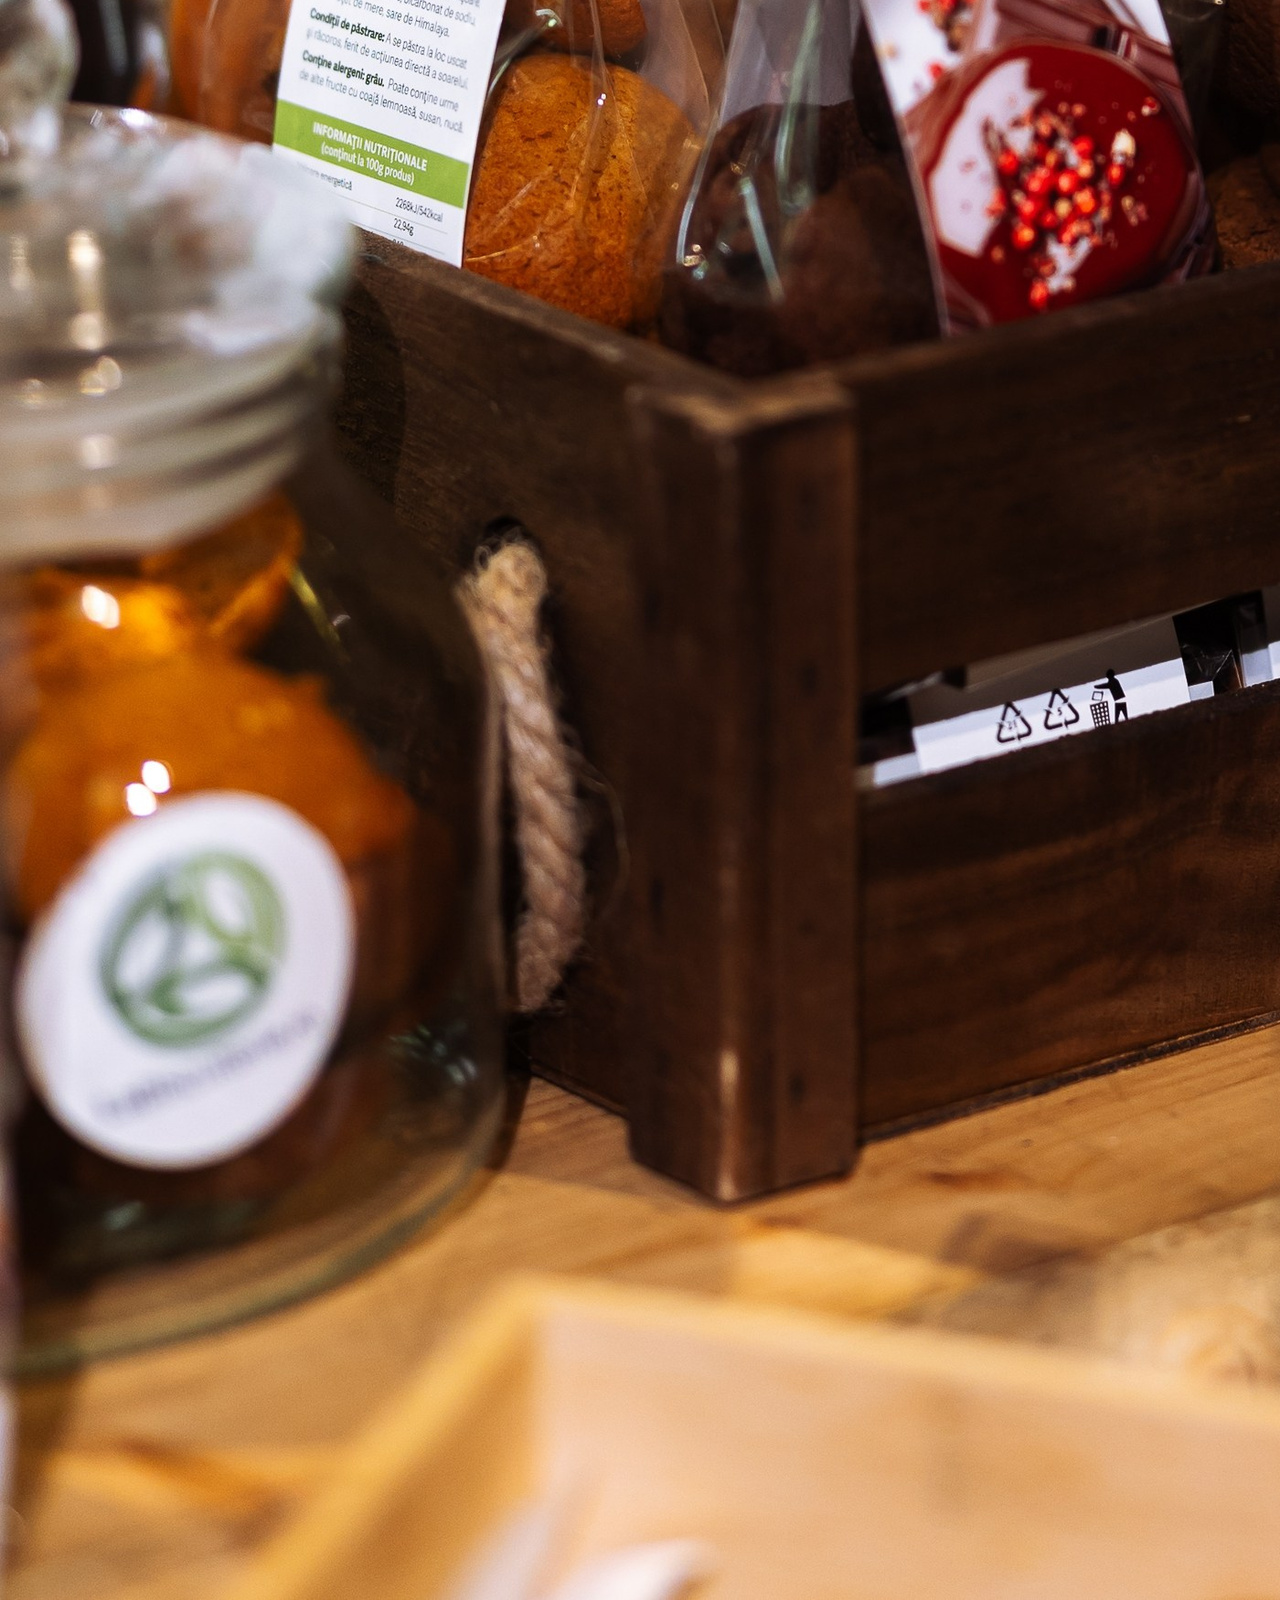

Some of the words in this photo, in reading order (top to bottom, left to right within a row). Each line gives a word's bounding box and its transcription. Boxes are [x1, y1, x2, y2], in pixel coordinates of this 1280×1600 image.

[385, 8, 403, 22] sare
[402, 12, 414, 26] de
[414, 15, 450, 37] Himalaya.
[443, 5, 455, 19] de
[340, 18, 351, 30] de
[350, 22, 386, 42] păstrare:
[385, 32, 392, 45] A
[392, 37, 402, 48] se
[402, 39, 426, 56] păstra
[426, 46, 434, 59] la
[434, 48, 446, 63] loc
[343, 37, 360, 54] ferit
[359, 43, 371, 57] de
[404, 58, 431, 78] directă
[431, 69, 437, 80] a
[332, 60, 366, 81] alergeni:
[365, 72, 385, 87] grâu.
[387, 77, 410, 96] Poate
[325, 75, 348, 95] fructe
[347, 86, 359, 98] cu
[359, 90, 380, 107] coajă
[380, 95, 417, 119] lemnoasă,
[357, 153, 365, 168] la
[366, 156, 385, 178] 100g
[384, 165, 415, 186] produs)
